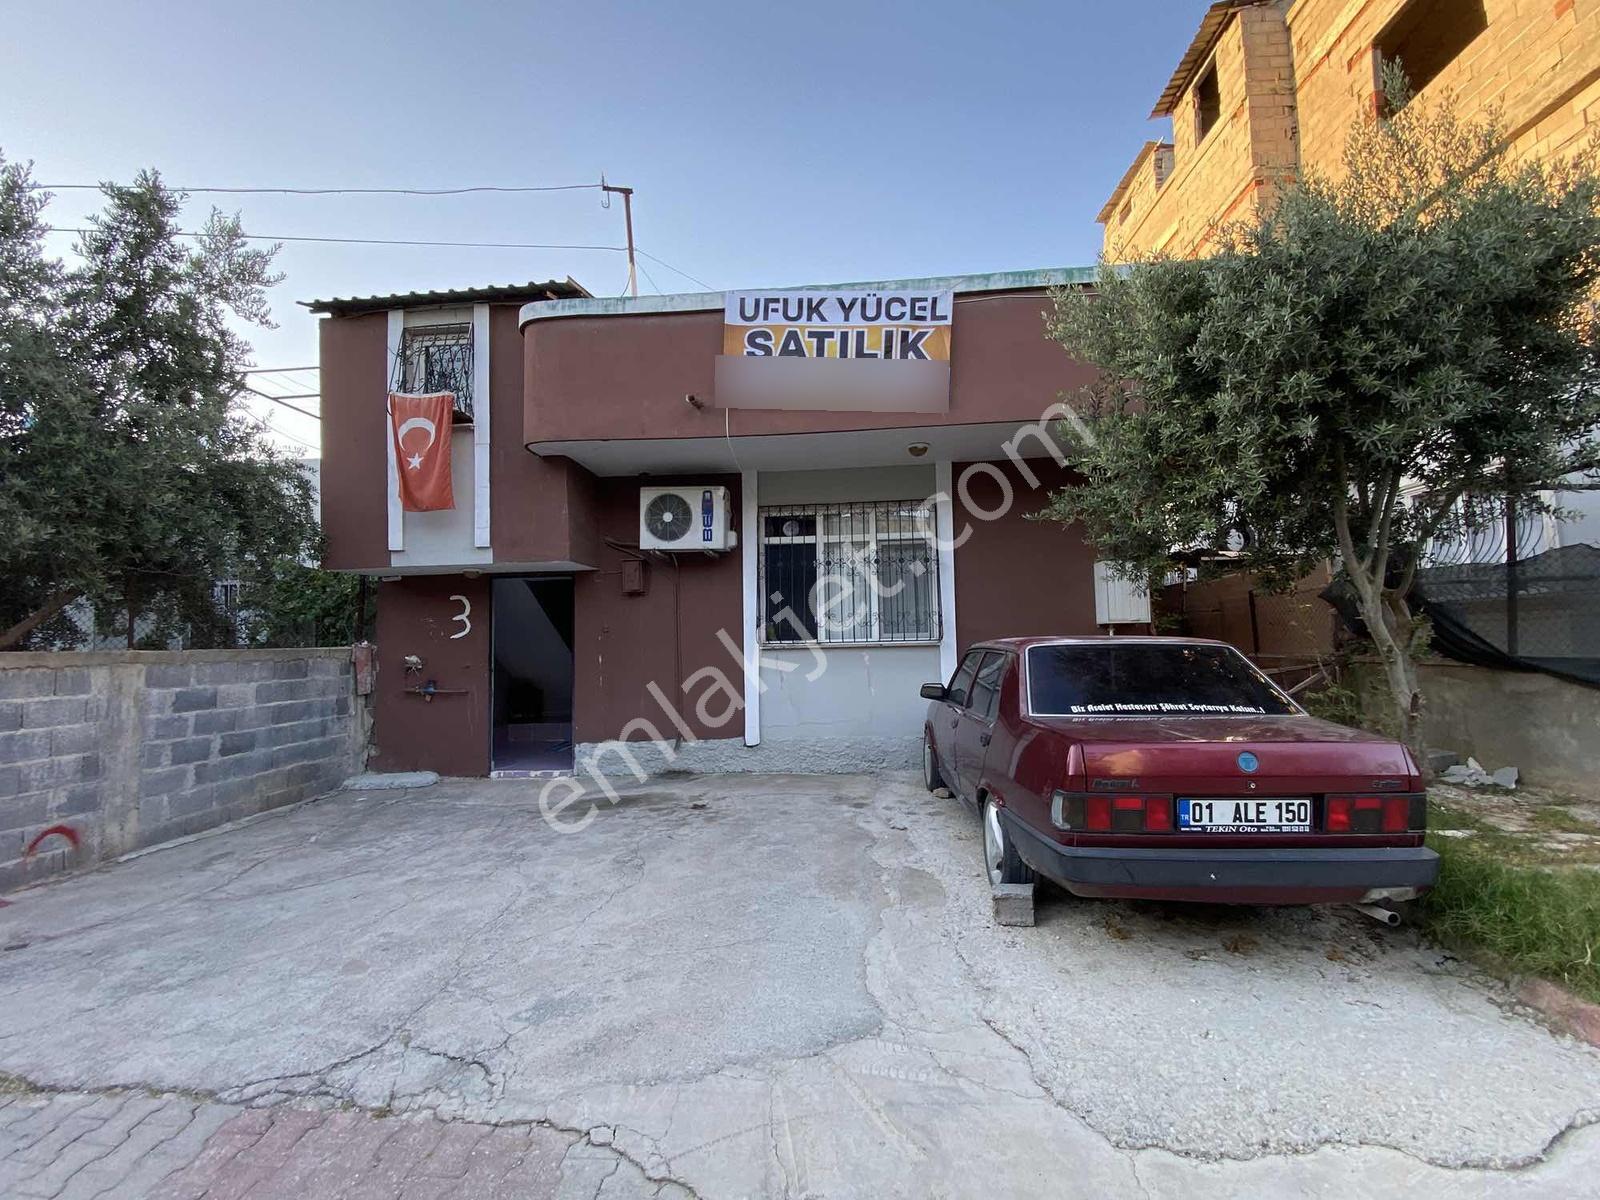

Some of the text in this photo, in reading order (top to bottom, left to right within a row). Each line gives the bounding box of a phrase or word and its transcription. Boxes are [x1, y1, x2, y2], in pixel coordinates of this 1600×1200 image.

[739, 293, 948, 322] UFUK YÜCEL
[744, 327, 935, 360] SATILIK
[449, 595, 471, 639] 3
[1070, 705, 1086, 713] Biz
[1191, 802, 1308, 823] 01 ALE 150
